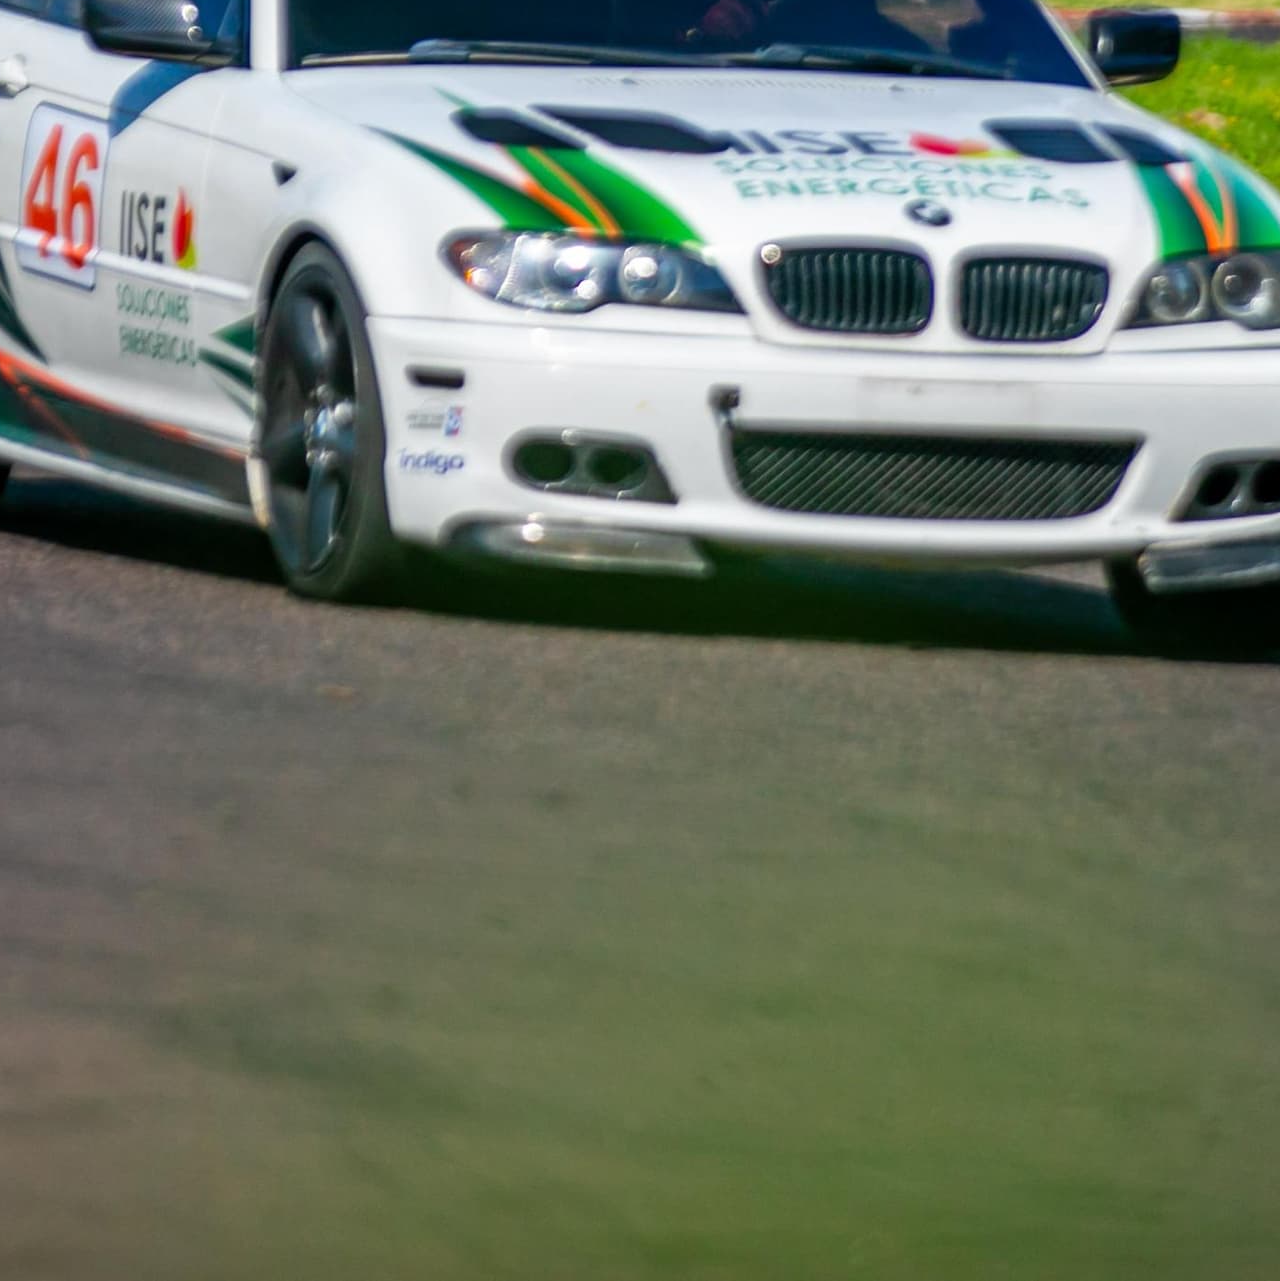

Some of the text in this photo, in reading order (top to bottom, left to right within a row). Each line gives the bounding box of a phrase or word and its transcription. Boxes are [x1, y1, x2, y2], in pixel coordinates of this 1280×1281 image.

[714, 157, 1053, 180] SOLUCIONES
[23, 122, 99, 270] 46
[120, 189, 166, 264] IISE
[399, 447, 464, 474] indigo
